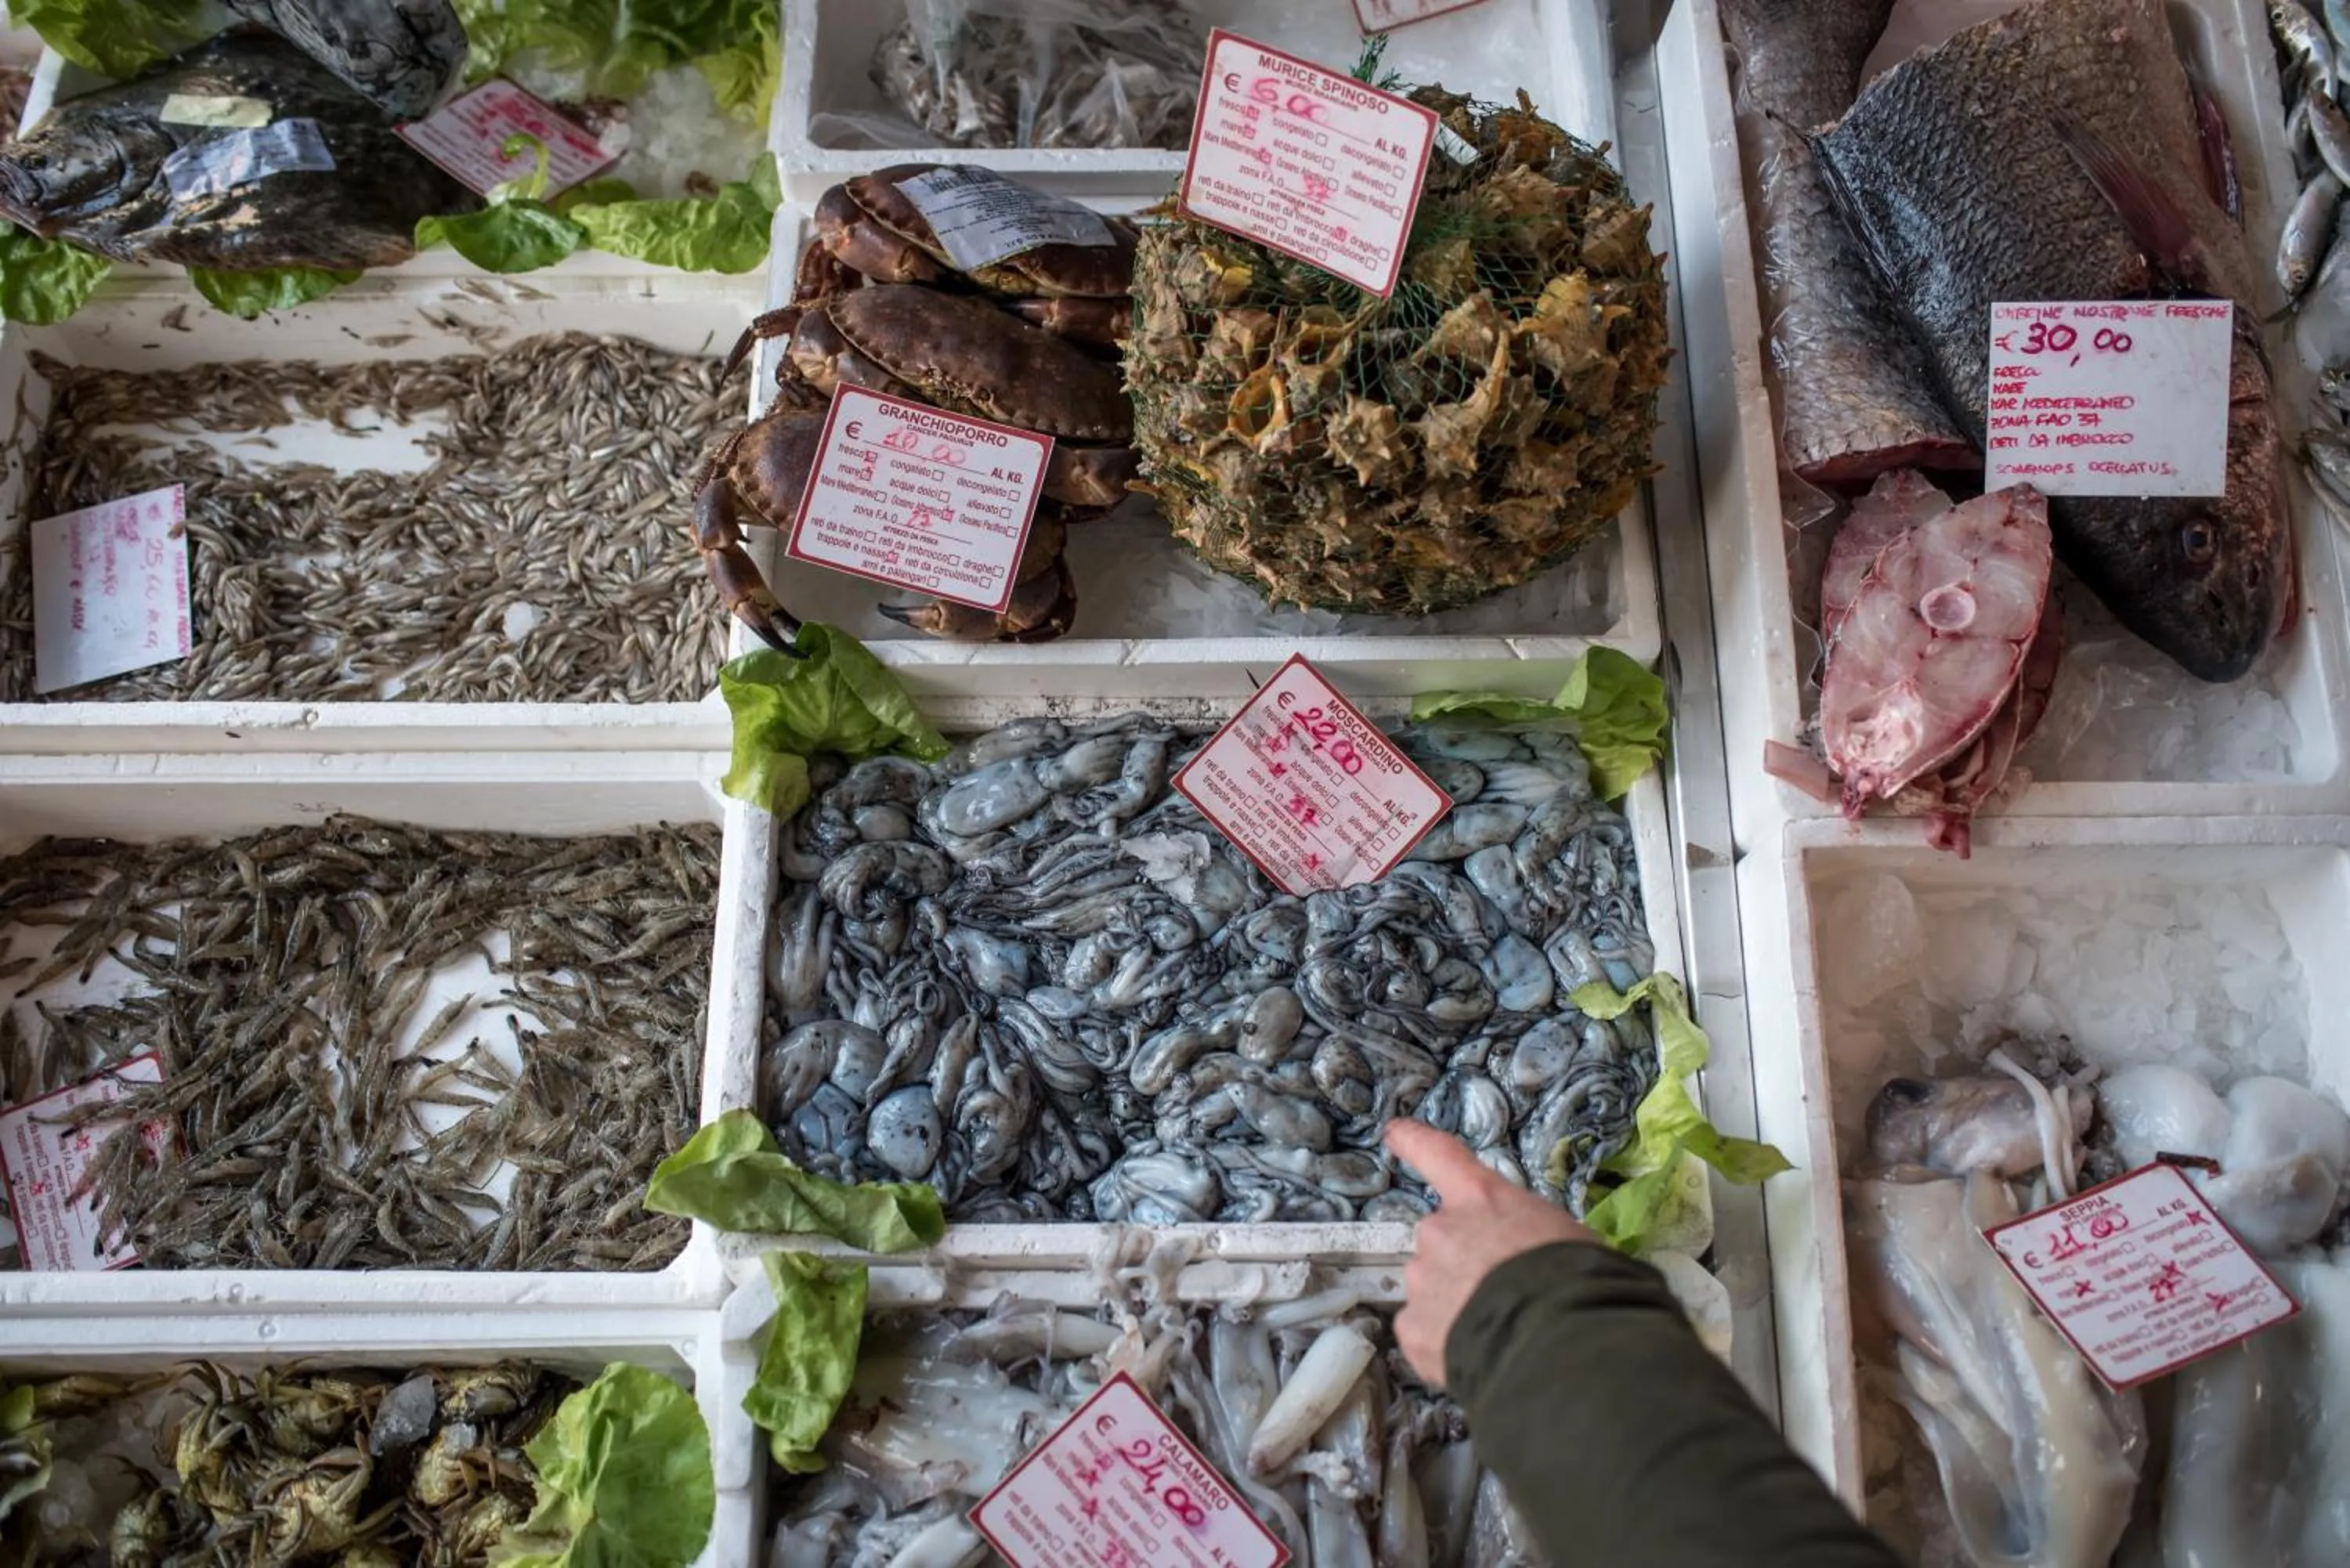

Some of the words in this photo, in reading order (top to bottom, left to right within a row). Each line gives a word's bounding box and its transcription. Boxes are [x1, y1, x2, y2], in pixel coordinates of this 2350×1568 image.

[1258, 55, 1318, 87] MURICE
[1321, 78, 1389, 114] SPINOSO
[1224, 73, 1241, 93] €
[1374, 136, 1389, 152] AL
[2020, 322, 2132, 367] 30,00
[878, 403, 1008, 447] GRANCHIOPORRO
[2030, 433, 2049, 447] DA
[2036, 414, 2072, 426] FAO
[2077, 413, 2102, 427] 37
[845, 421, 863, 439] €
[990, 467, 1004, 479] AL
[1278, 691, 1296, 709] €
[1382, 797, 1398, 813] AL
[1325, 698, 1405, 775] MOSCARDINO
[1203, 757, 1219, 773] reti
[2057, 1195, 2112, 1222] SEPPIA
[2023, 1251, 2044, 1270] €
[1096, 1414, 1117, 1436] €
[1155, 1432, 1231, 1512] CALAMARO
